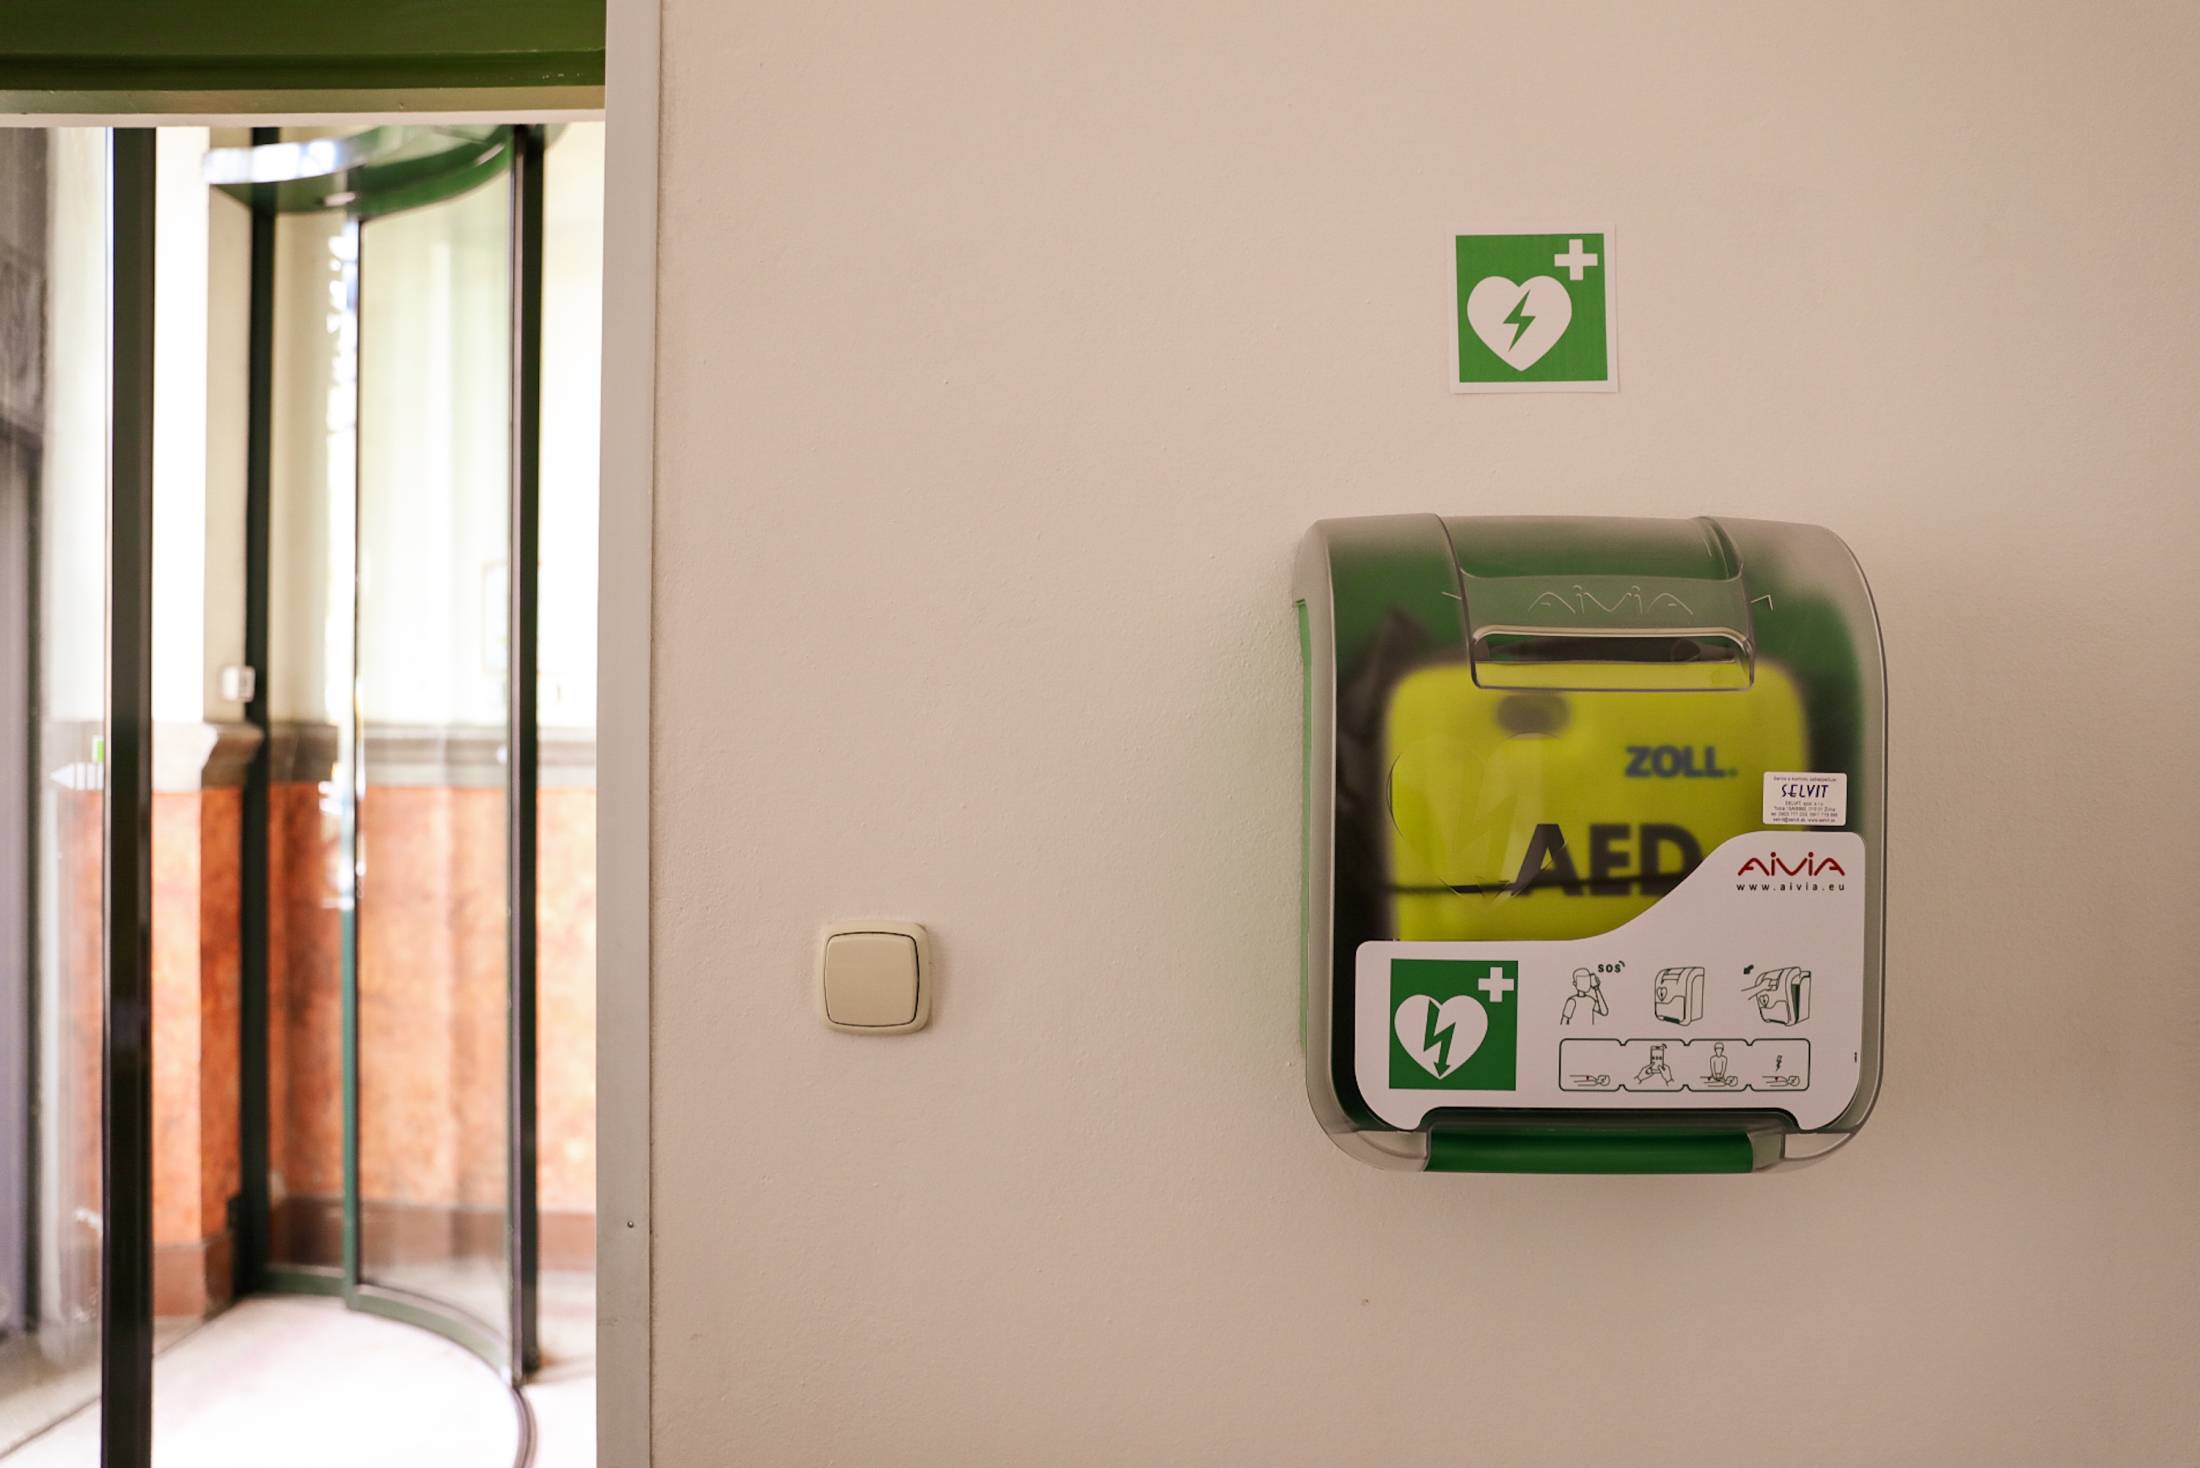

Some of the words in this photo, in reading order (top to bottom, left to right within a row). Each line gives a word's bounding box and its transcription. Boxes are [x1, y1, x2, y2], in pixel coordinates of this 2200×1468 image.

[1781, 783, 1829, 798] SELVIT
[1511, 822, 1704, 897] AED
[1736, 881, 1845, 891] www.aivia.eu
[1597, 963, 1622, 974] SOS
